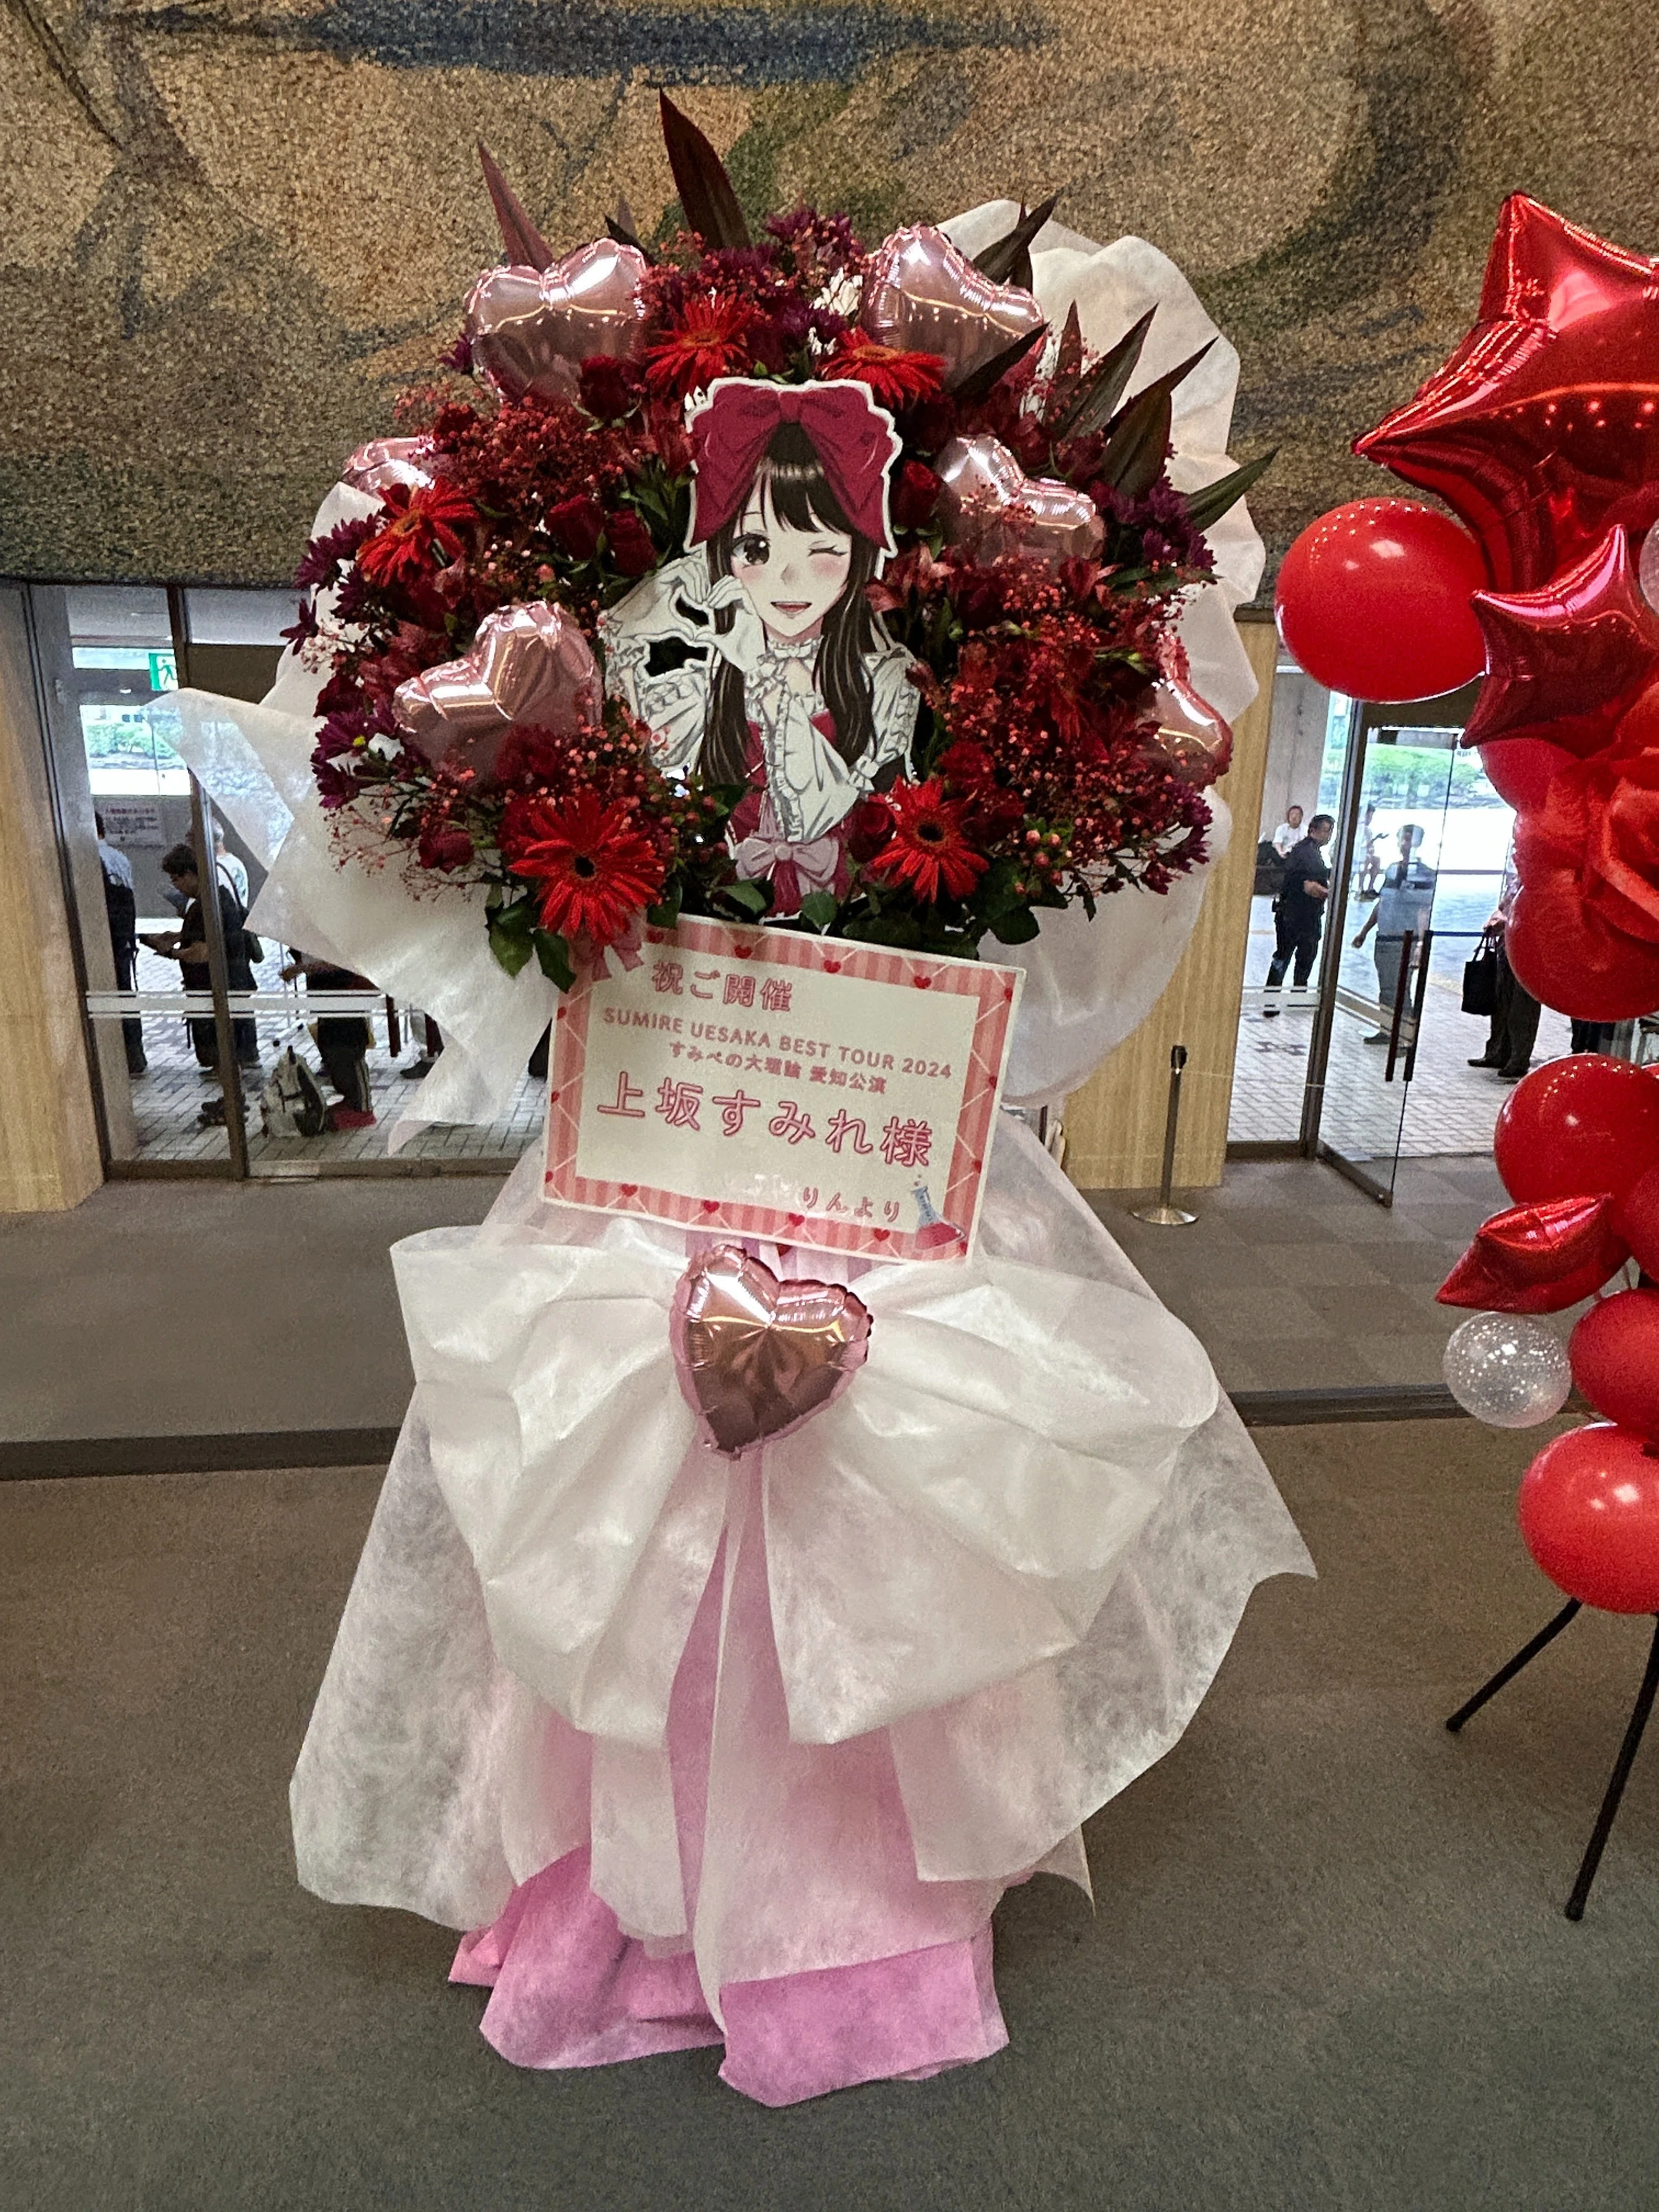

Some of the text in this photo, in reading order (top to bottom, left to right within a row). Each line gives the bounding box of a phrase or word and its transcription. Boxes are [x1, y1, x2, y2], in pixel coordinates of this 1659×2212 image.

[652, 961, 793, 1013] 祝ご開催
[603, 1007, 952, 1079] SUMIRE UESAKA BEST TOUR 2024
[809, 1065, 887, 1094] 愛知公演
[597, 1071, 933, 1167] 上坂すみれ様
[803, 1187, 900, 1223] りんより
